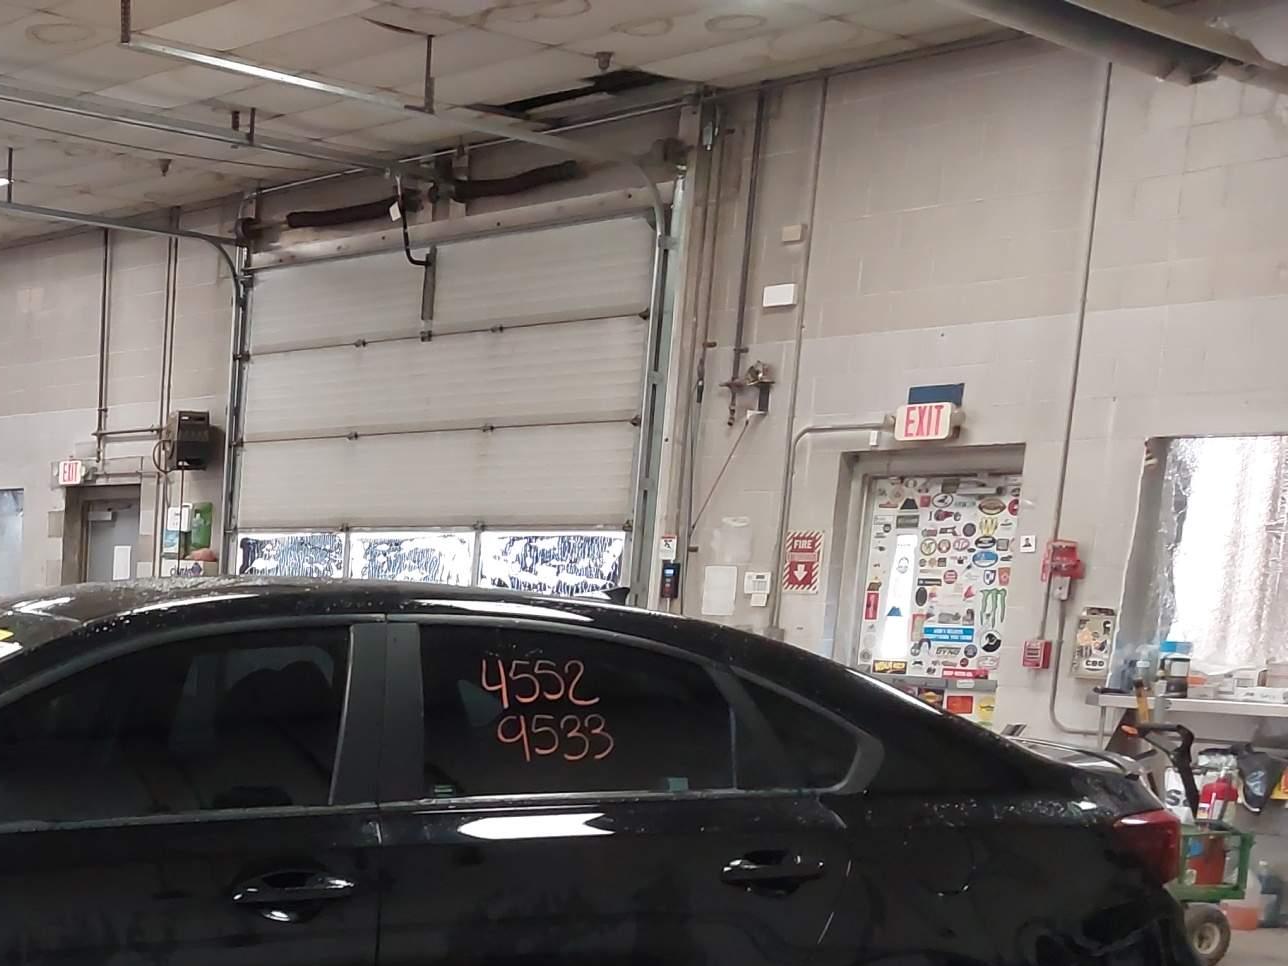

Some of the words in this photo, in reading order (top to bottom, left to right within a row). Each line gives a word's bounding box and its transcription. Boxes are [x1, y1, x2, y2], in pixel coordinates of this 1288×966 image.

[904, 404, 945, 437] EXIT
[62, 462, 79, 482] EXIT
[793, 539, 813, 549] FIRE
[480, 657, 601, 710] 4552
[496, 713, 615, 763] 9533
